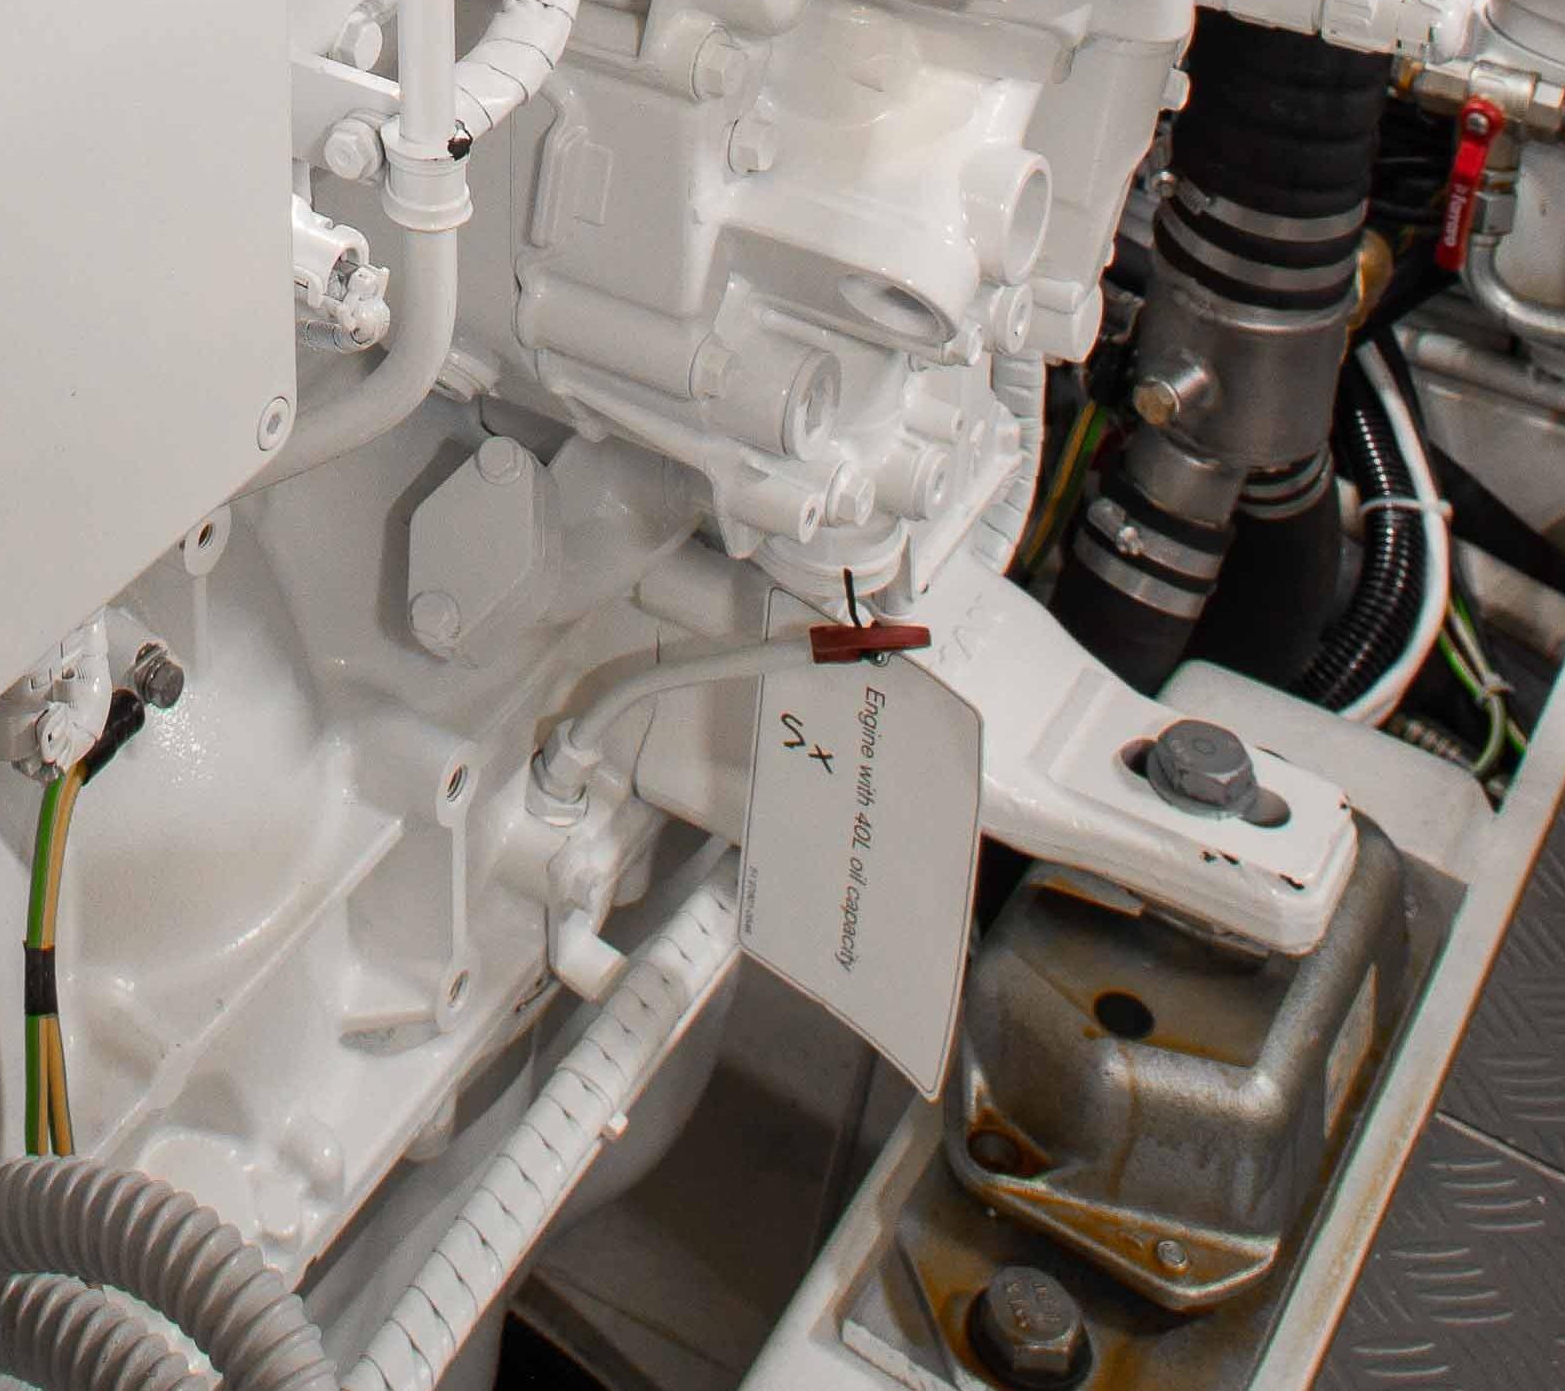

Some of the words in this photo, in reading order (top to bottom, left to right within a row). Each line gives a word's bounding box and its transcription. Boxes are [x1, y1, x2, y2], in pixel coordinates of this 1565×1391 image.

[857, 686, 886, 760] Engine
[857, 763, 876, 808] with
[851, 814, 872, 850] 40L
[849, 856, 868, 887] oil
[834, 886, 861, 974] capacity
